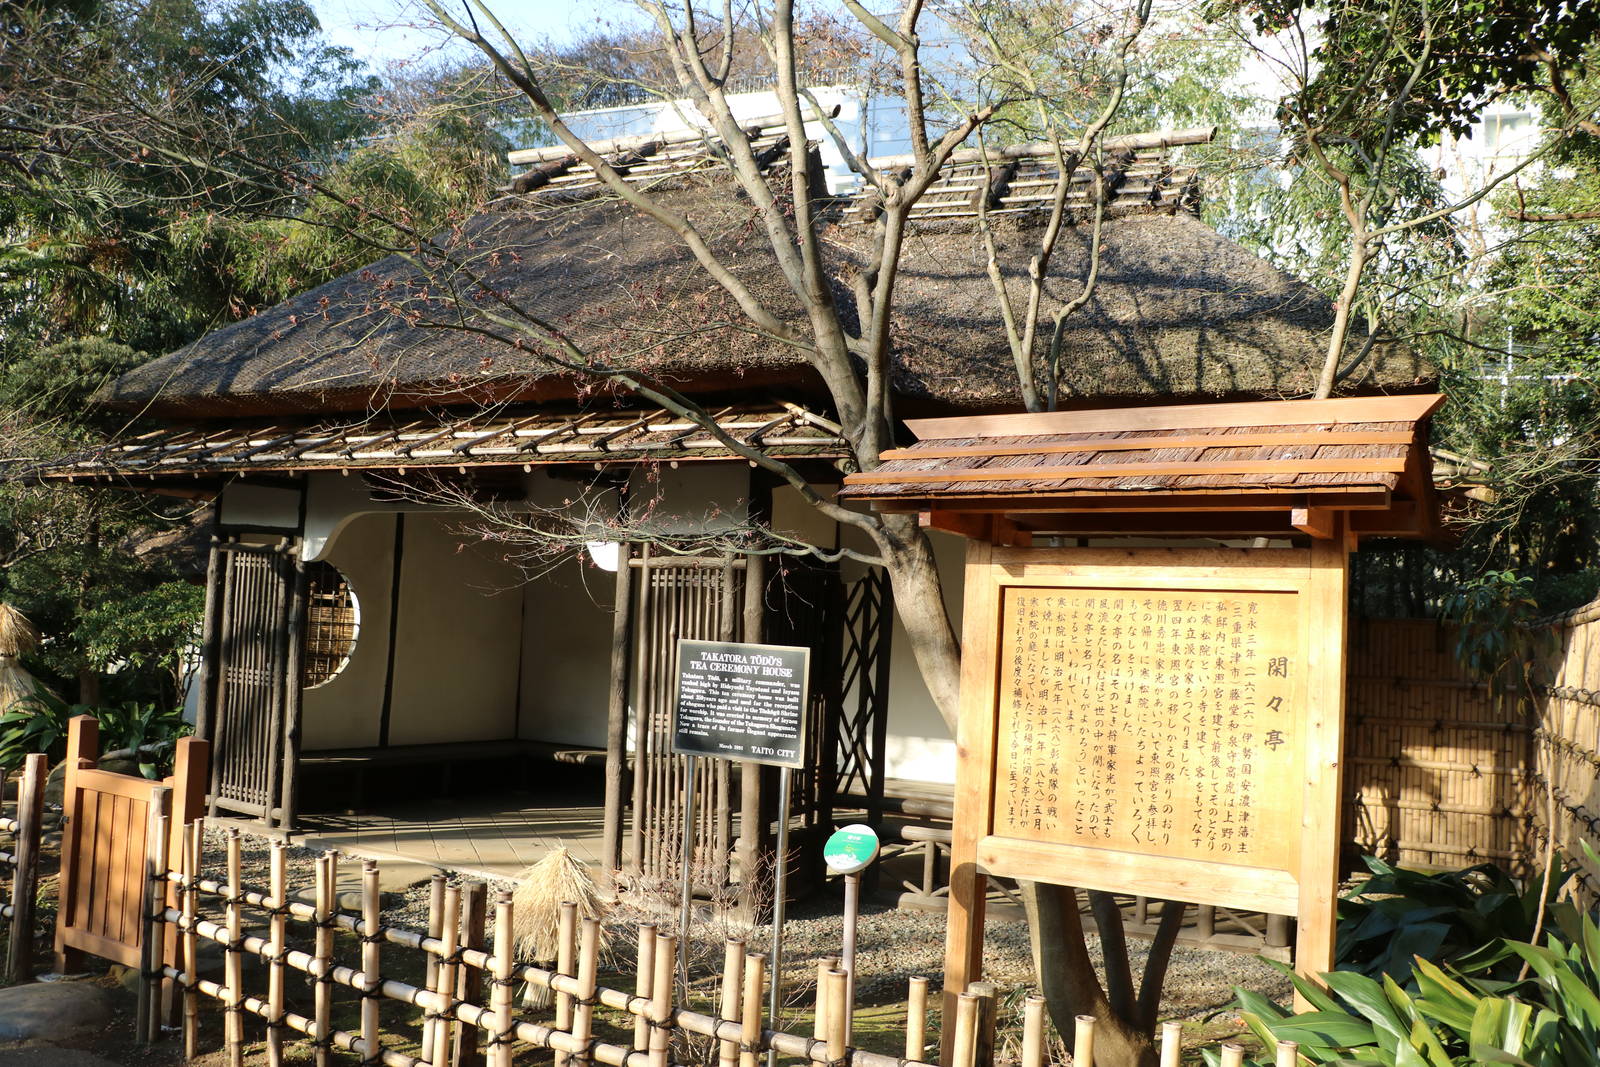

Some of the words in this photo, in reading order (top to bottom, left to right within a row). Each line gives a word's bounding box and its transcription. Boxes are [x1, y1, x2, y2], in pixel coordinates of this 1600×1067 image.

[701, 651, 748, 664] TAKATORA
[690, 661, 708, 671] TEA
[710, 663, 760, 675] CEREMONY
[762, 666, 793, 678] HOUSE
[774, 702, 798, 710] reception
[1264, 657, 1288, 752] 閑々亭
[751, 745, 774, 756] TAITO
[777, 747, 796, 758] CITY
